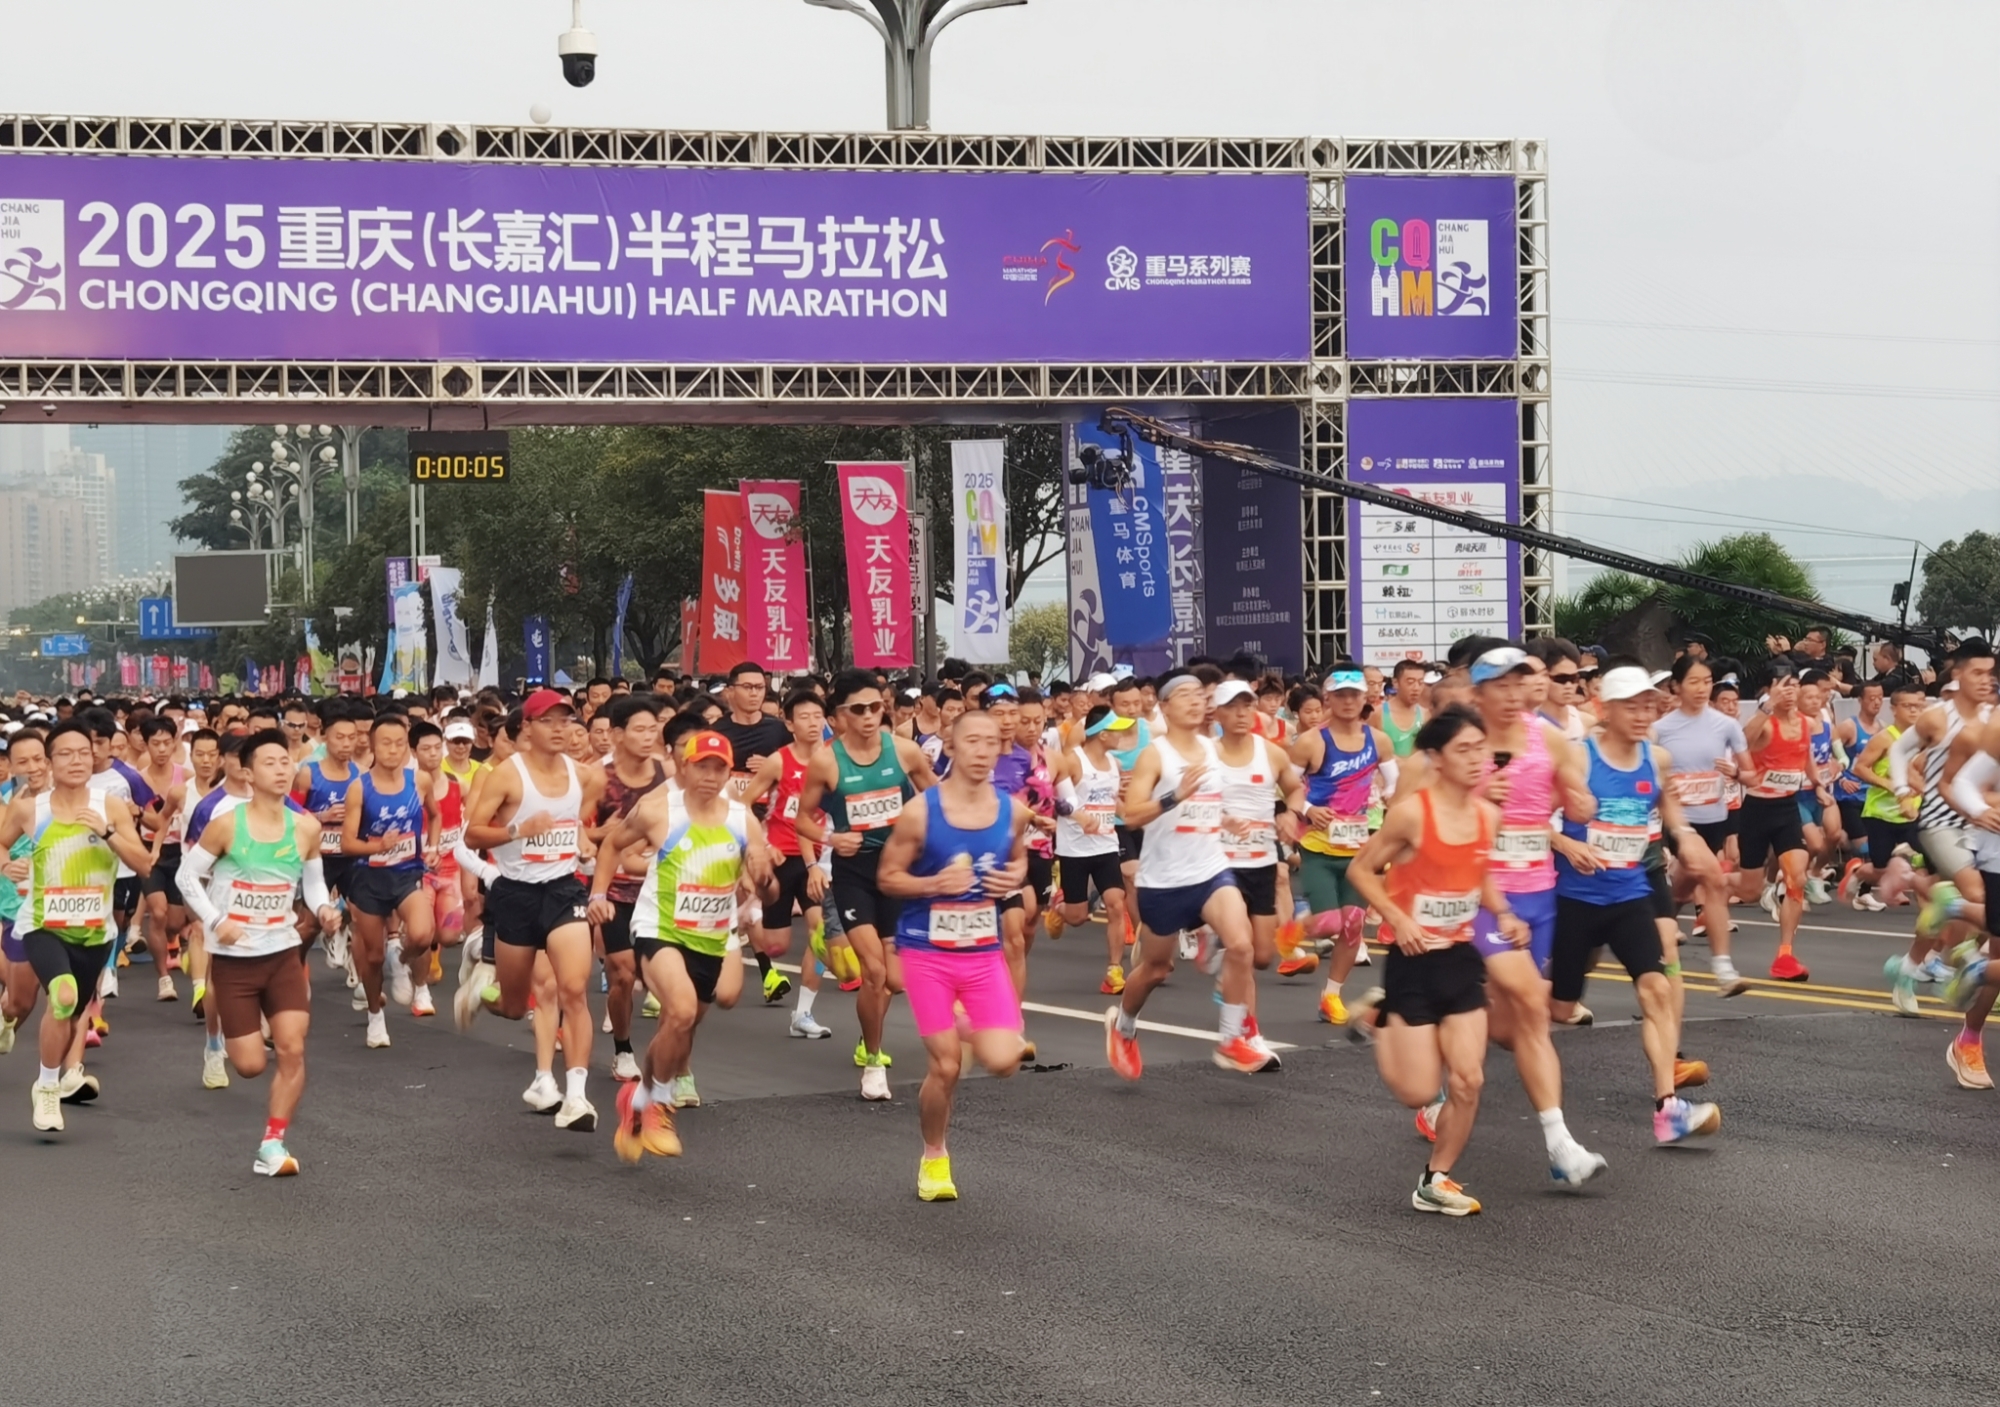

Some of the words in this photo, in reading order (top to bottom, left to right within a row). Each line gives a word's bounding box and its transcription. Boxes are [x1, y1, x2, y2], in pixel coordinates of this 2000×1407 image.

[0, 203, 40, 214] CHANG
[2, 215, 20, 226] JIA
[1437, 223, 1470, 233] CHANG
[1, 229, 21, 239] HUI
[78, 201, 948, 280] 2025重庆(长嘉汇)半程马拉松
[1439, 234, 1454, 244] JIA
[1438, 245, 1455, 255] HUI
[1145, 255, 1252, 277] 重马系列赛
[1105, 278, 1141, 291] CMS
[78, 279, 338, 315] CHONGQING
[350, 277, 637, 321] (CHANGJIAHUI)
[648, 286, 736, 318] HALF
[746, 288, 948, 319] MARATHON
[416, 456, 505, 479] 0:00:05
[964, 473, 994, 488] 2025
[853, 487, 895, 511] 天友
[1071, 514, 1090, 533] CHAN
[1108, 498, 1137, 589] 重马体育
[1132, 496, 1156, 598] CMSports
[761, 548, 793, 661] 天友乳业
[865, 535, 898, 656] 天友乳业
[713, 572, 741, 642] 多威
[525, 829, 575, 848] A00022
[47, 894, 102, 913] A00878
[233, 893, 288, 912] A02037
